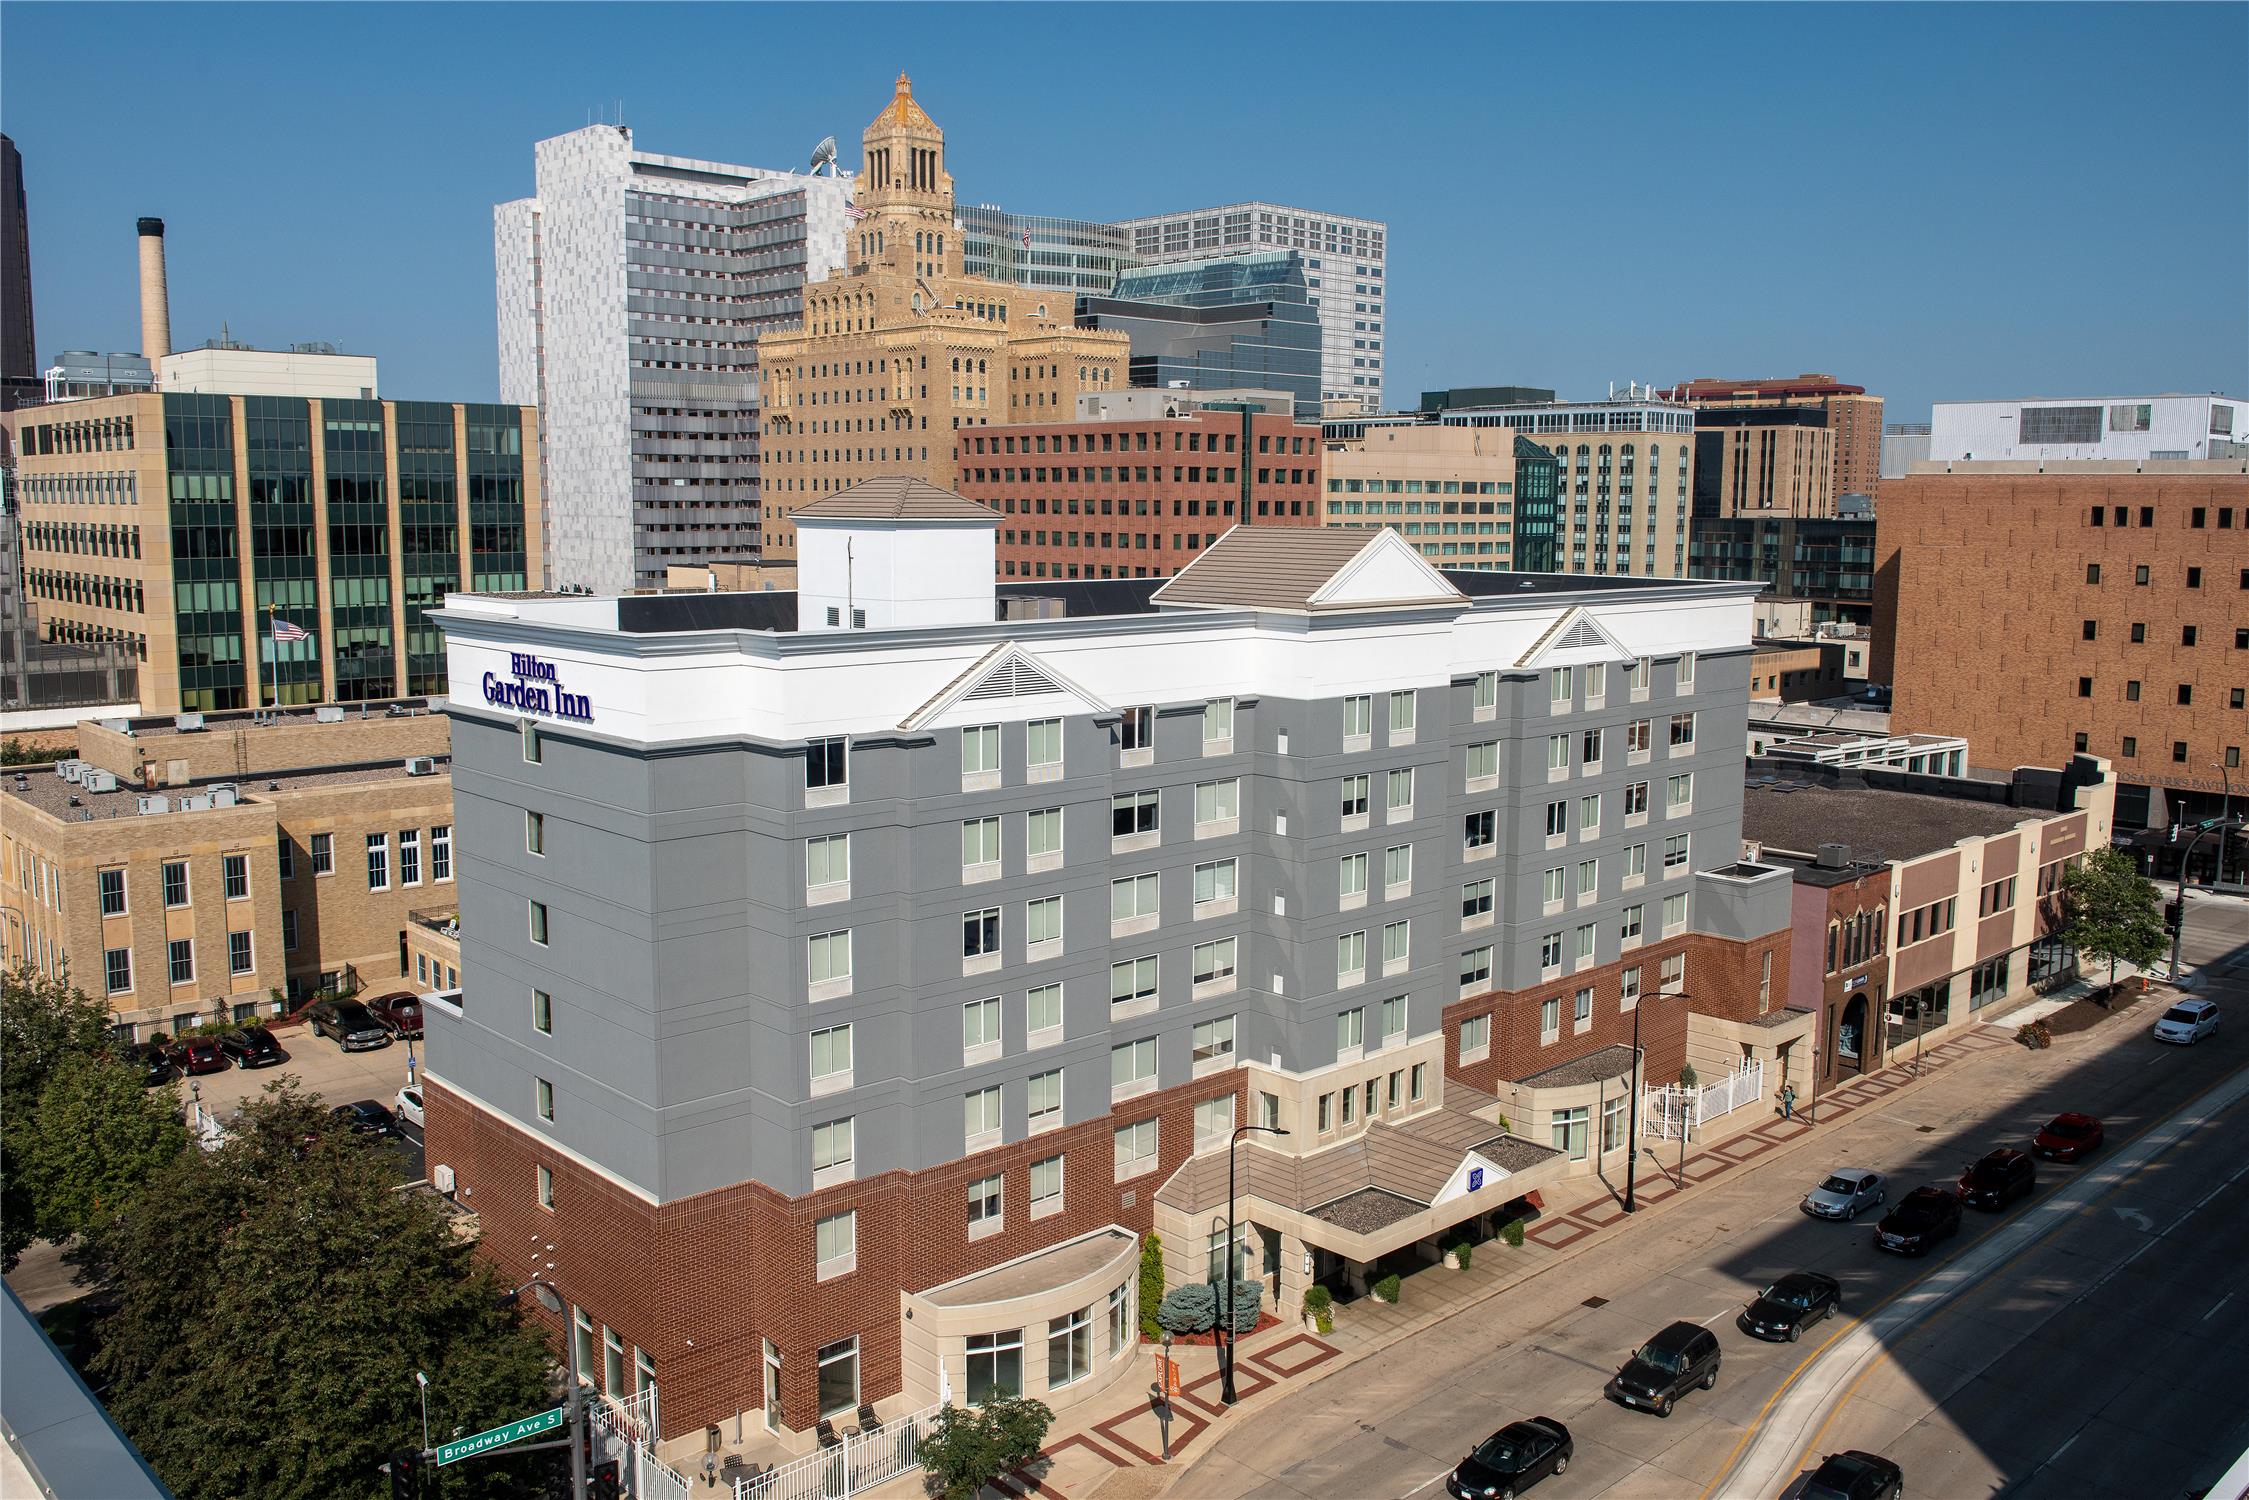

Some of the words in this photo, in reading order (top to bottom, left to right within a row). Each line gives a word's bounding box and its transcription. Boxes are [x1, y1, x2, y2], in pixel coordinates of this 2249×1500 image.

[511, 652, 556, 680] Hilton
[483, 672, 550, 713] Garden
[554, 683, 592, 720] Inn
[444, 1431, 510, 1459] Broadway
[517, 1420, 541, 1435] Ave
[547, 1414, 555, 1424] S
